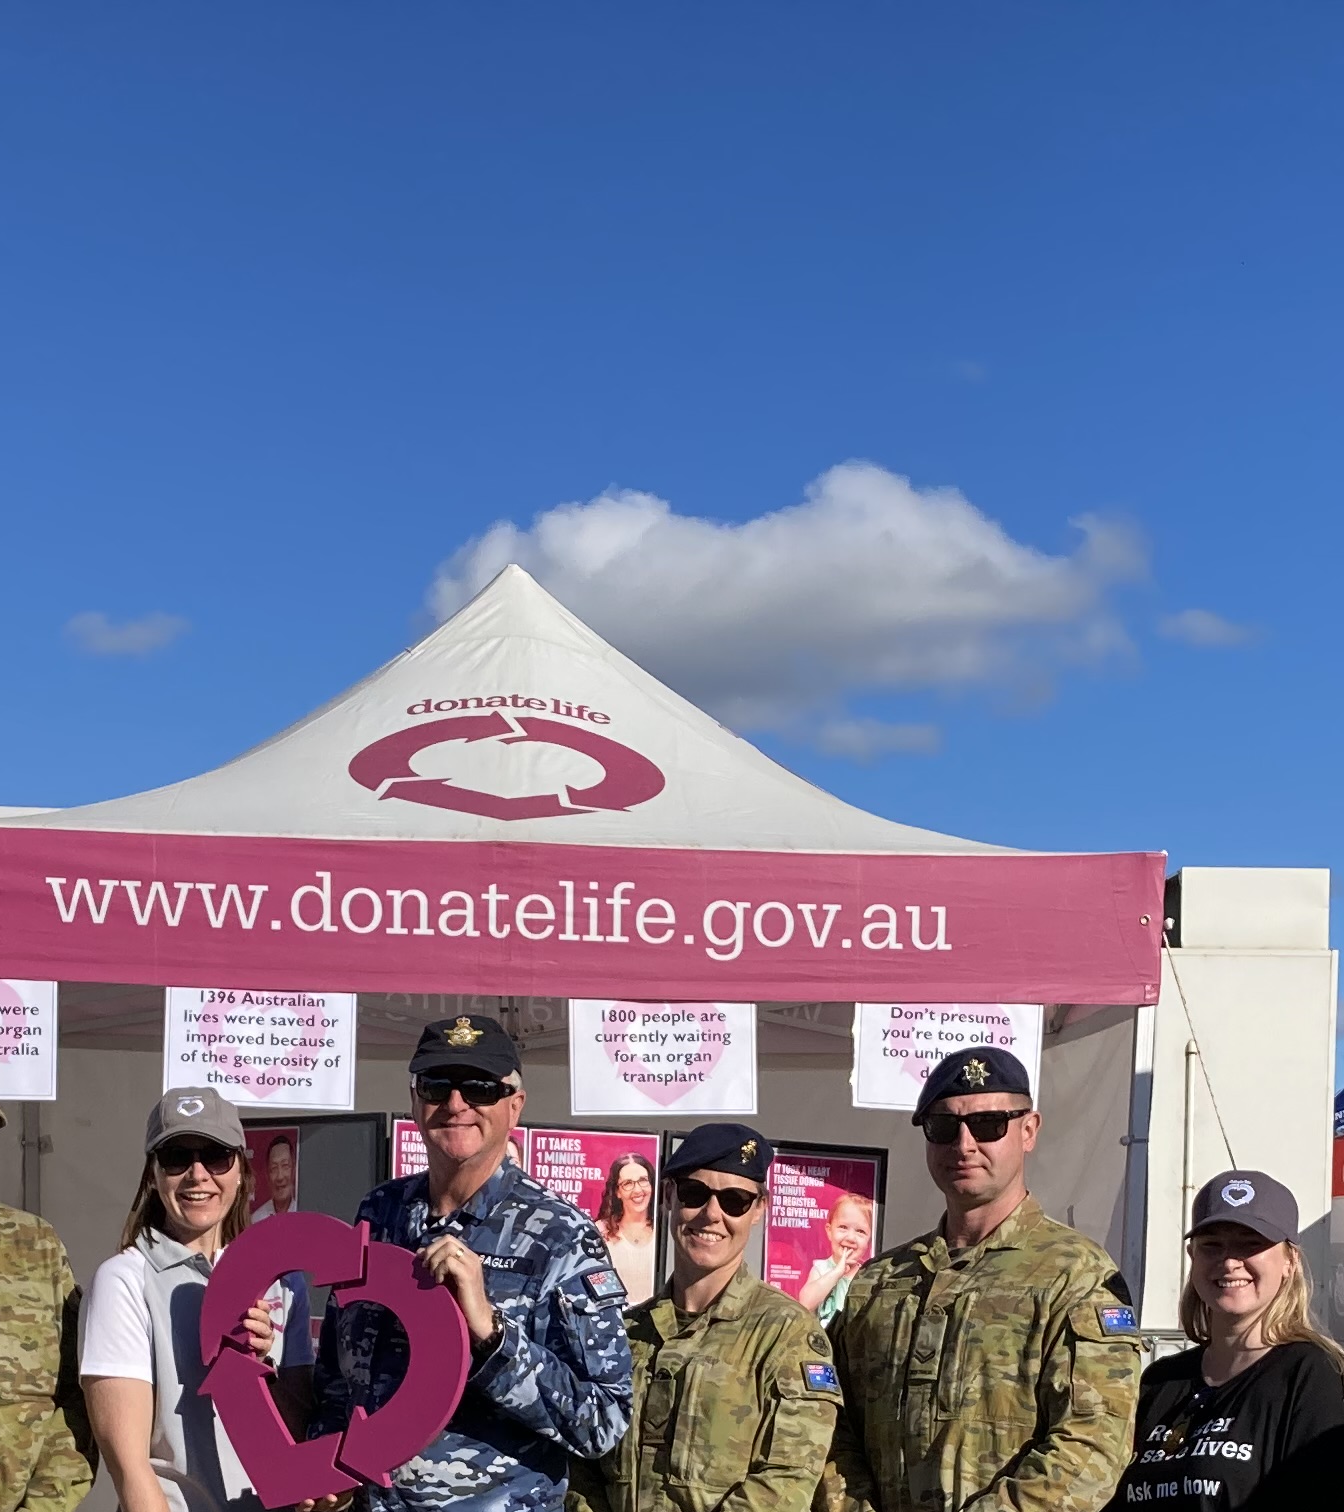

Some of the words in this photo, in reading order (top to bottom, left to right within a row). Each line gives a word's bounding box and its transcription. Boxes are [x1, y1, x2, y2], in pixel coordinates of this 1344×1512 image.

[406, 693, 612, 726] donatelife
[45, 871, 953, 961] www.donatelife.gov.au
[200, 990, 236, 1004] 1396
[241, 992, 326, 1008] Australian
[184, 1010, 219, 1023] lives
[224, 1014, 265, 1025] were
[270, 1015, 315, 1027] saved
[321, 1017, 339, 1028] or
[601, 1010, 636, 1023] 1800
[642, 1010, 695, 1026] people
[700, 1012, 727, 1022] are
[890, 1006, 936, 1021] Don't
[940, 1012, 1011, 1026] presume
[186, 1030, 265, 1048] improved
[270, 1034, 335, 1048] because
[595, 1030, 668, 1046] currently
[673, 1029, 732, 1046] waiting
[882, 1027, 933, 1041] you're
[938, 1030, 964, 1042] too
[969, 1031, 994, 1044] old
[999, 1035, 1017, 1046] or
[614, 1050, 637, 1063] for
[642, 1053, 661, 1063] an
[666, 1052, 712, 1066] organ
[882, 1046, 909, 1058] too
[180, 1050, 197, 1062] of
[201, 1050, 228, 1063] the
[233, 1054, 319, 1071] generosity
[324, 1055, 341, 1068] of
[207, 1070, 251, 1085] these
[256, 1073, 313, 1087] donors
[623, 1069, 705, 1086] transplant
[536, 1137, 548, 1150] IT
[549, 1137, 581, 1151] TAKES
[536, 1152, 542, 1164] 1
[544, 1151, 586, 1166] MINUTE
[536, 1165, 550, 1178] TO
[551, 1166, 605, 1181] REGISTER.
[774, 1163, 781, 1174] IT
[807, 1166, 830, 1177] HEART
[547, 1179, 582, 1194] COULD
[773, 1174, 799, 1185] TISSUE
[799, 1176, 825, 1187] DONOR
[778, 1185, 806, 1196] MINUTE
[772, 1195, 782, 1206] TO
[783, 1196, 818, 1208] REGISTER.
[786, 1207, 808, 1218] GIVEN
[771, 1218, 777, 1228] A
[777, 1217, 811, 1229] LIFETIME.
[1190, 1436, 1254, 1461] lives
[1127, 1481, 1153, 1503] Ask
[1156, 1480, 1178, 1499] me
[1183, 1475, 1221, 1497] how
